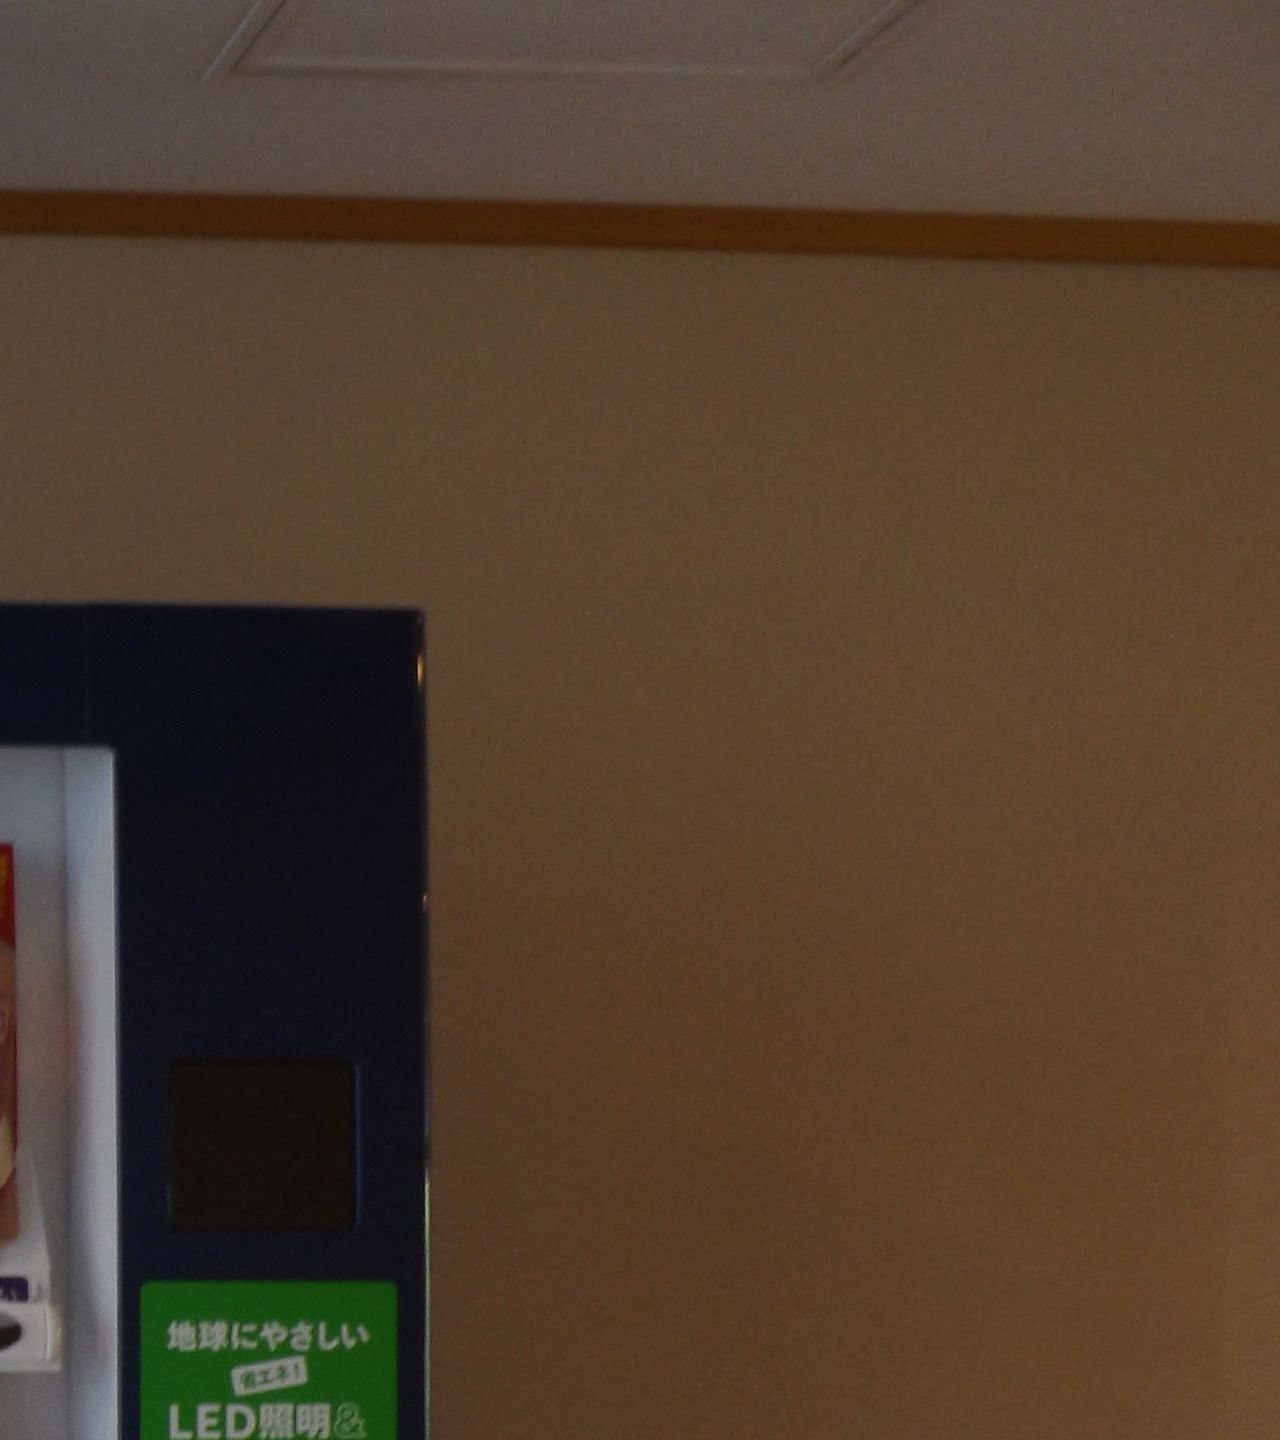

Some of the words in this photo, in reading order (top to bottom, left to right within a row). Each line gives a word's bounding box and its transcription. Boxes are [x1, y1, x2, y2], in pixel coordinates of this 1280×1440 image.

[166, 1318, 371, 1353] 地球にやさしい
[168, 1401, 368, 1440] LED照明&
